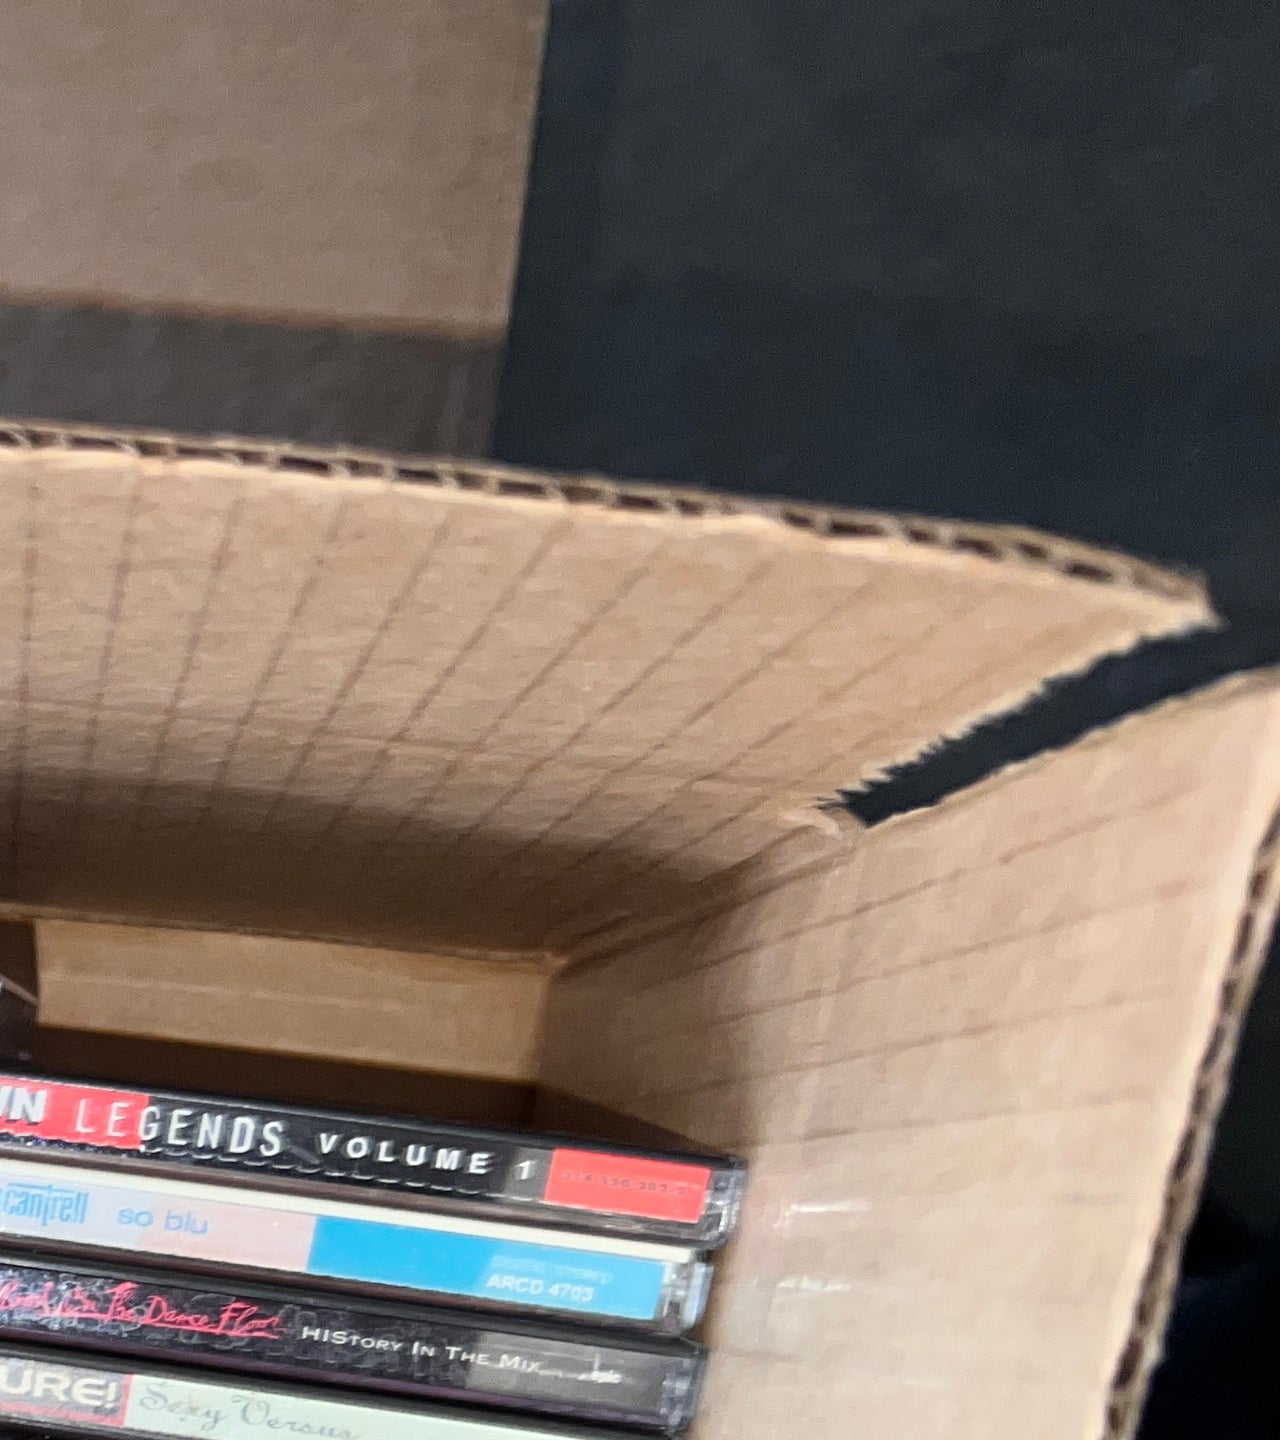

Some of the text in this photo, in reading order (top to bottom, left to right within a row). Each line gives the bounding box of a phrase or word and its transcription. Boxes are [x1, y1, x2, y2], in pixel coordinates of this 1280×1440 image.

[74, 1097, 283, 1157] LEGENDS
[318, 1132, 492, 1174] VOLUME
[164, 1209, 210, 1234] blu
[138, 1291, 217, 1332] Dance
